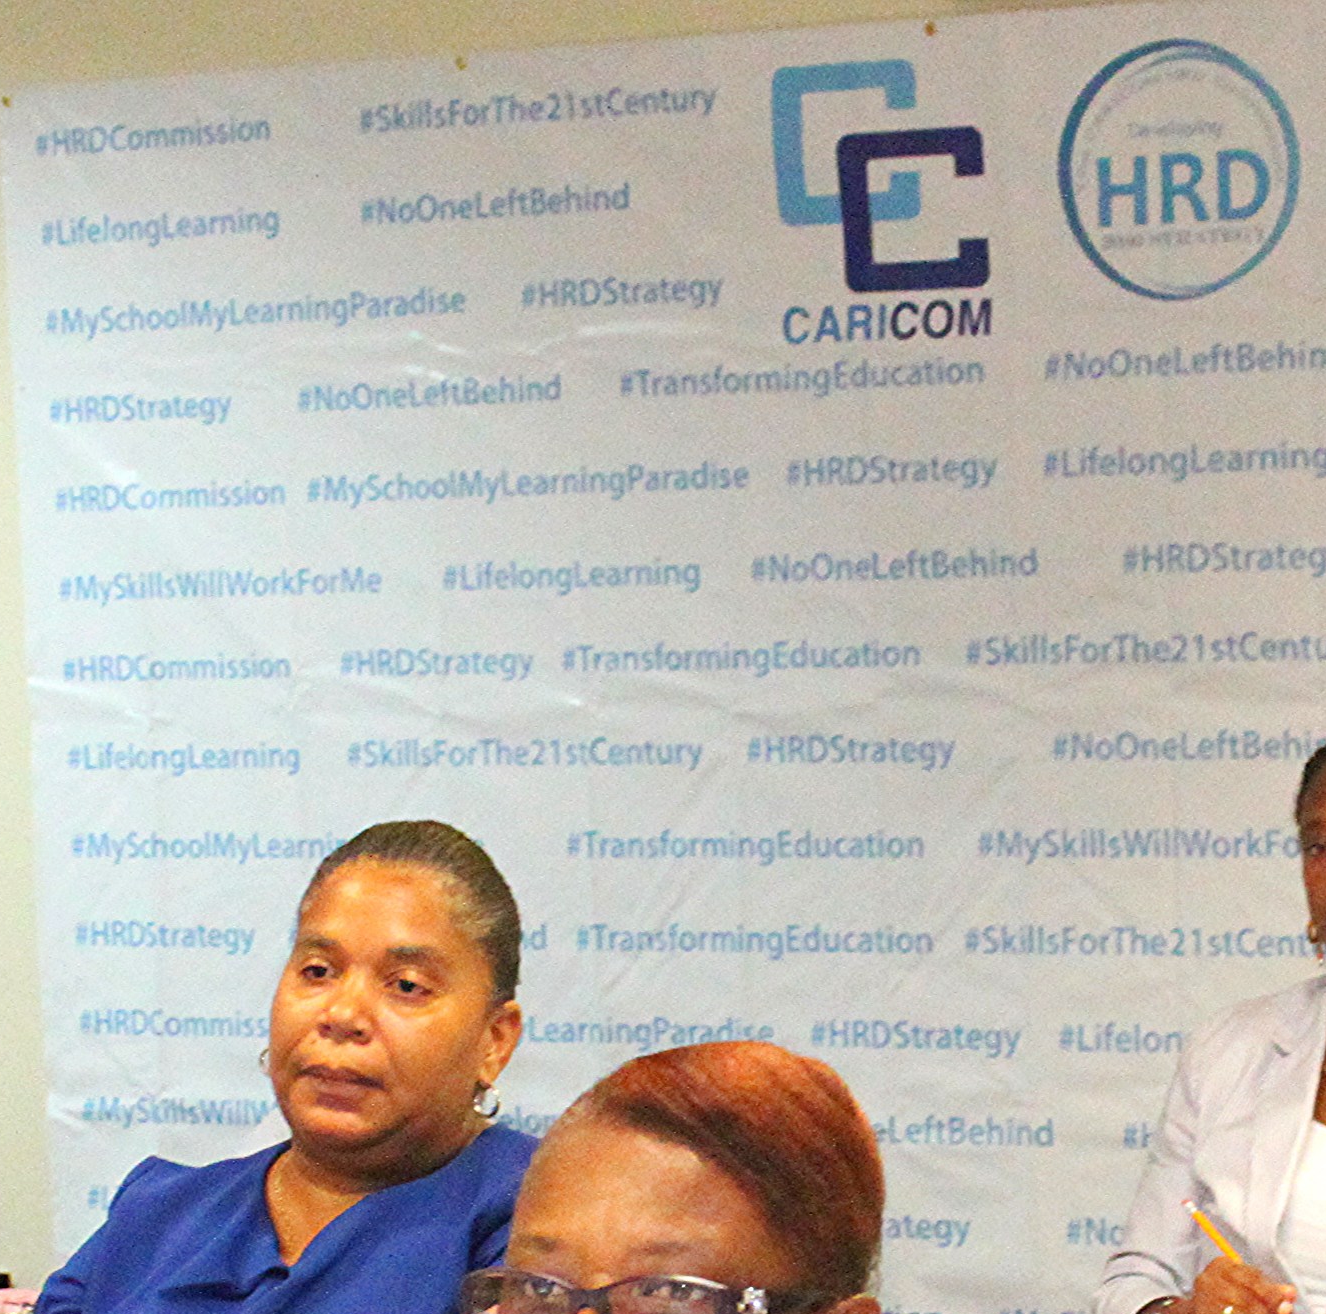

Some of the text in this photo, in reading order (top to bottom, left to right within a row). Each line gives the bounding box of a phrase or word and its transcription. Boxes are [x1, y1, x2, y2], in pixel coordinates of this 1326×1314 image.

[35, 87, 717, 155] #HRDCommission #SkillsForThe21stCentury
[41, 181, 631, 248] #LifelongLearning #NoOneLeftBehind
[1096, 148, 1272, 228] HRD
[45, 276, 722, 341] #MySchoolMyLearningParadise #HRDStrategy
[781, 299, 994, 346] CARICOM
[49, 357, 986, 426] #HRDStrategy #NoOneLeftBehind #TransformingEducation
[54, 480, 287, 513] #HRDCommission
[307, 461, 750, 509] #MySchoolMyLearningParadise
[786, 455, 998, 490] #HRDStrategy
[59, 566, 383, 607] #MySkillsWillWorkForMe
[442, 560, 702, 597] #LifelongLearning
[751, 547, 1040, 582] #NoOneLeftBehind
[62, 652, 292, 682] #HRDCommission
[340, 647, 534, 681] #HRDStrategy
[562, 640, 921, 678] #TransformingEducation
[67, 741, 302, 777] #LifelongLearning
[346, 735, 703, 769] #SkillsForThe21stCentury
[747, 731, 955, 772] #HRDStrategy
[1052, 729, 1326, 761] #NoOneLeftBehi
[71, 832, 347, 865] #MySchoolMyLearni
[566, 828, 925, 867] #TransformingEducation
[978, 828, 1300, 865] #MySkillsWillWorkFo
[75, 919, 255, 956] #HRDStrategy
[575, 922, 934, 962] #TransformingEducation
[964, 925, 1323, 958] #SkillsForThe21stCent
[79, 1008, 268, 1038] #HRDCommiss
[810, 1019, 1022, 1059] #HRDStrategy
[79, 1097, 1056, 1147] #MySkillsWillW eLeftBehind
